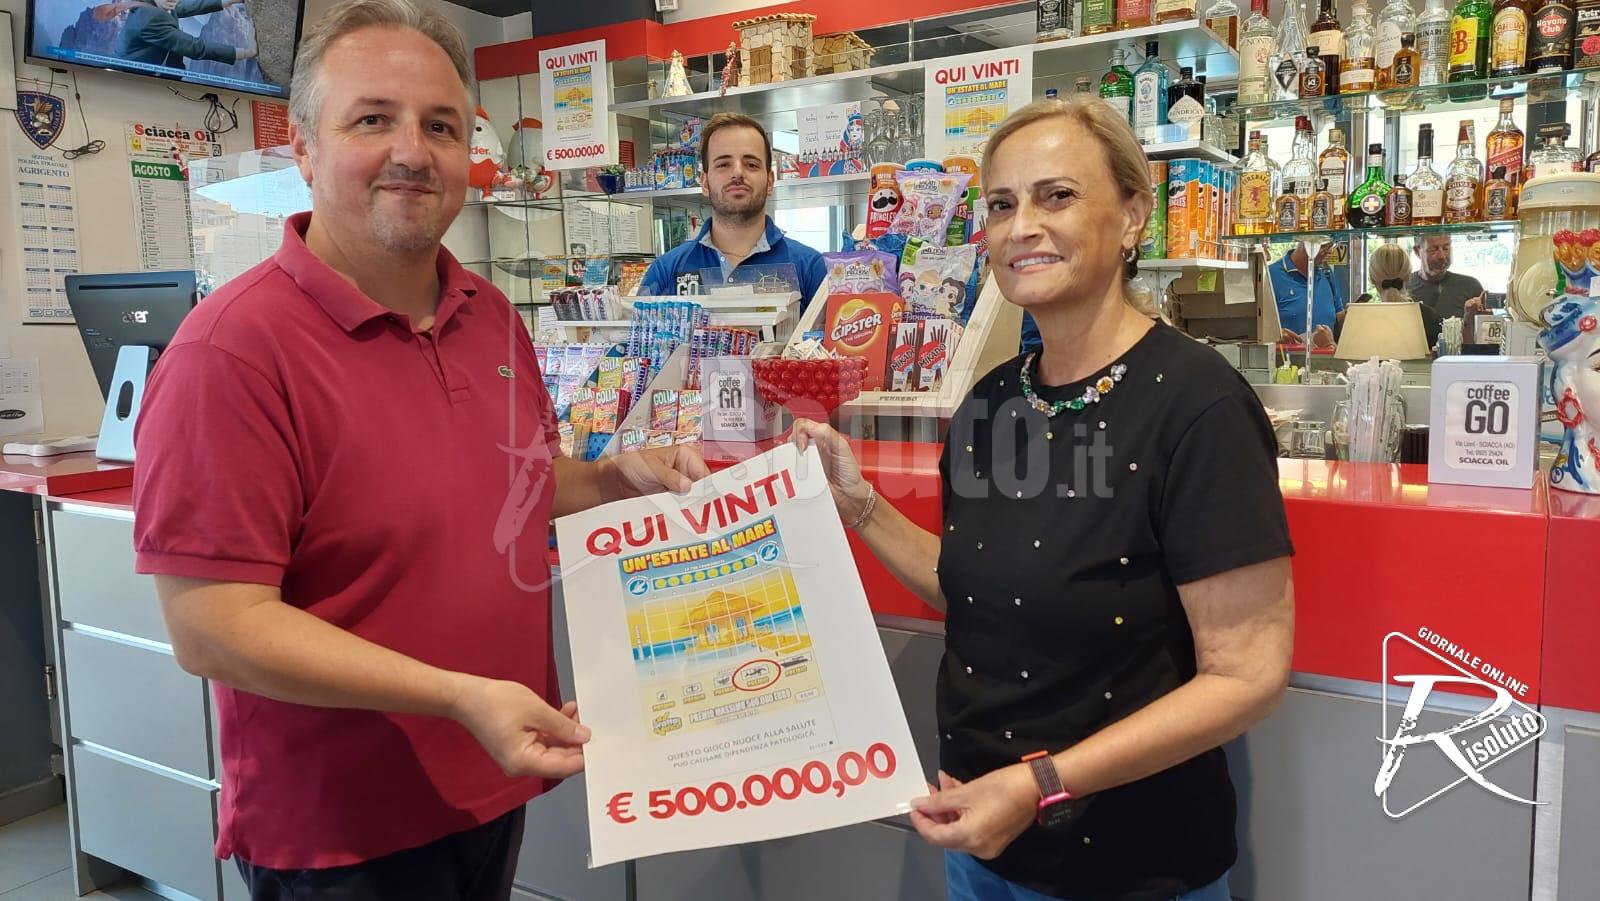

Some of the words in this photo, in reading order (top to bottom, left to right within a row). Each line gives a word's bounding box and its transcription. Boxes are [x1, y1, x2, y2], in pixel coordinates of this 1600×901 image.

[1537, 18, 1567, 27] Havana
[1542, 25, 1561, 33] Club
[546, 56, 566, 70] QUI
[568, 50, 598, 66] VINTI
[935, 67, 965, 84] QUI
[972, 59, 1019, 79] VINTI
[134, 124, 190, 140] Sciacca
[194, 130, 216, 142] Oil
[547, 150, 552, 160] €
[555, 144, 605, 159] 500.000,00
[18, 166, 70, 177] AGRIGENTO
[134, 164, 171, 177] AGOSTO
[676, 273, 700, 282] coffee
[676, 281, 699, 296] GO
[831, 313, 883, 341] CIPSTER
[918, 343, 947, 369] MIKADO
[600, 359, 621, 372] GOLIA
[623, 359, 641, 372] GOLI
[719, 377, 741, 388] coffee
[573, 389, 593, 403] GOLIA
[596, 389, 617, 403] GOLIA
[653, 391, 675, 406] GOLIA
[680, 391, 702, 407] GOLIA
[719, 387, 742, 409] GO
[1467, 384, 1510, 403] coffee
[1464, 400, 1510, 435] GO
[622, 429, 645, 446] GOLIA
[1479, 441, 1503, 449] SCIACCA
[1459, 457, 1493, 465] SCIACCA
[1495, 457, 1510, 466] OIL
[586, 513, 669, 556] QUI
[680, 468, 796, 535] VINTI
[622, 543, 709, 573] UN'ESTATE
[711, 538, 731, 557] AL
[731, 520, 777, 550] MARE
[667, 748, 701, 761] QUESTO
[703, 741, 730, 753] GIOCO
[732, 734, 760, 746] NUOCE
[763, 727, 784, 739] ALLA
[785, 719, 816, 732] SALUTE
[690, 753, 722, 765] CAUSARE
[770, 731, 815, 746] PATOLOGICA
[605, 791, 638, 824] €
[648, 742, 897, 820] 500.000,00
